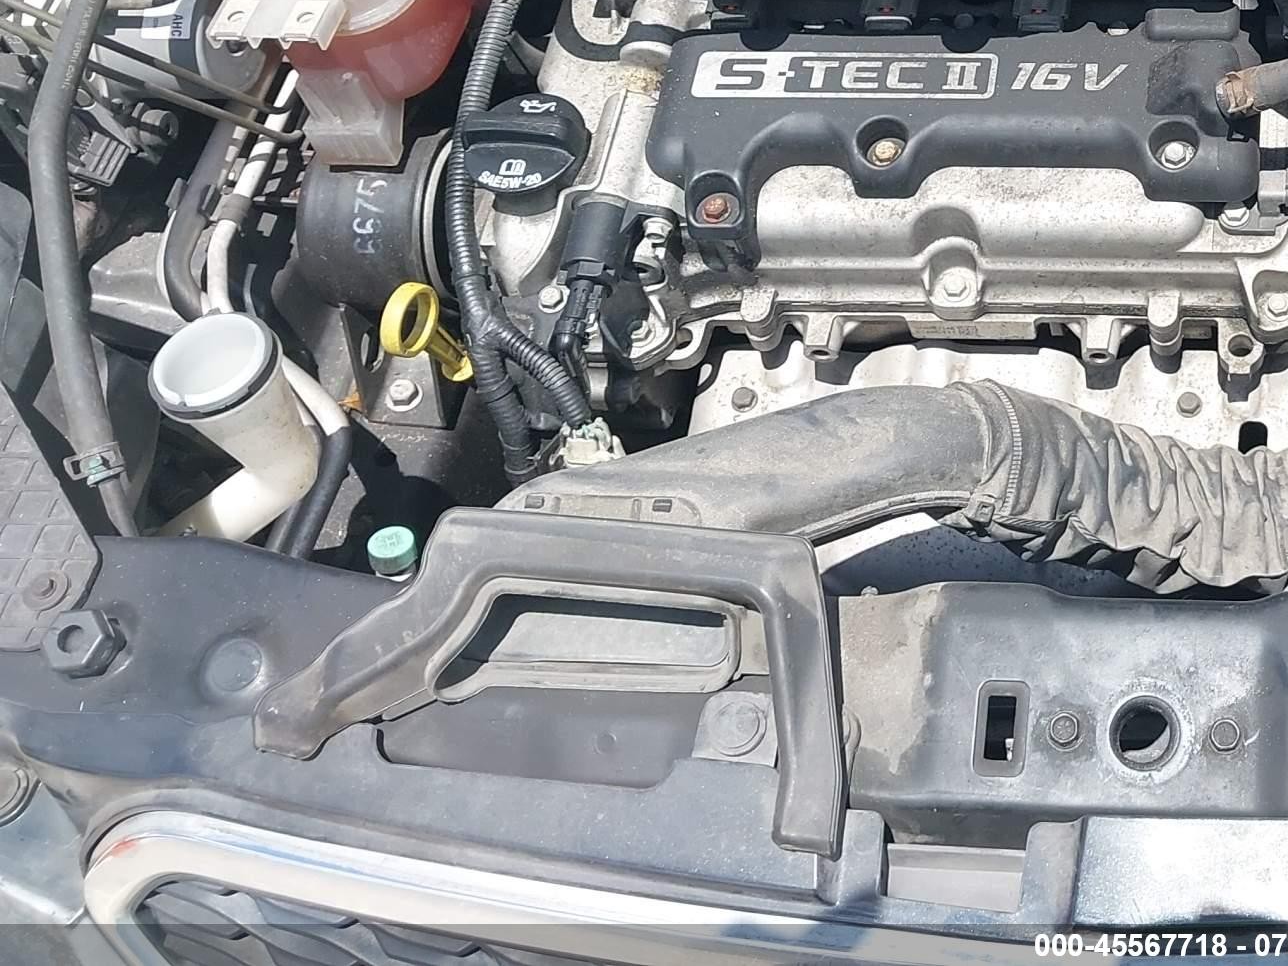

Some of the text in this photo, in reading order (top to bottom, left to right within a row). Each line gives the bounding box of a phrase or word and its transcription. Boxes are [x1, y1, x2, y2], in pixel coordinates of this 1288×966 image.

[171, 14, 184, 37] AHC
[942, 62, 979, 91] II
[1010, 62, 1129, 91] 16V
